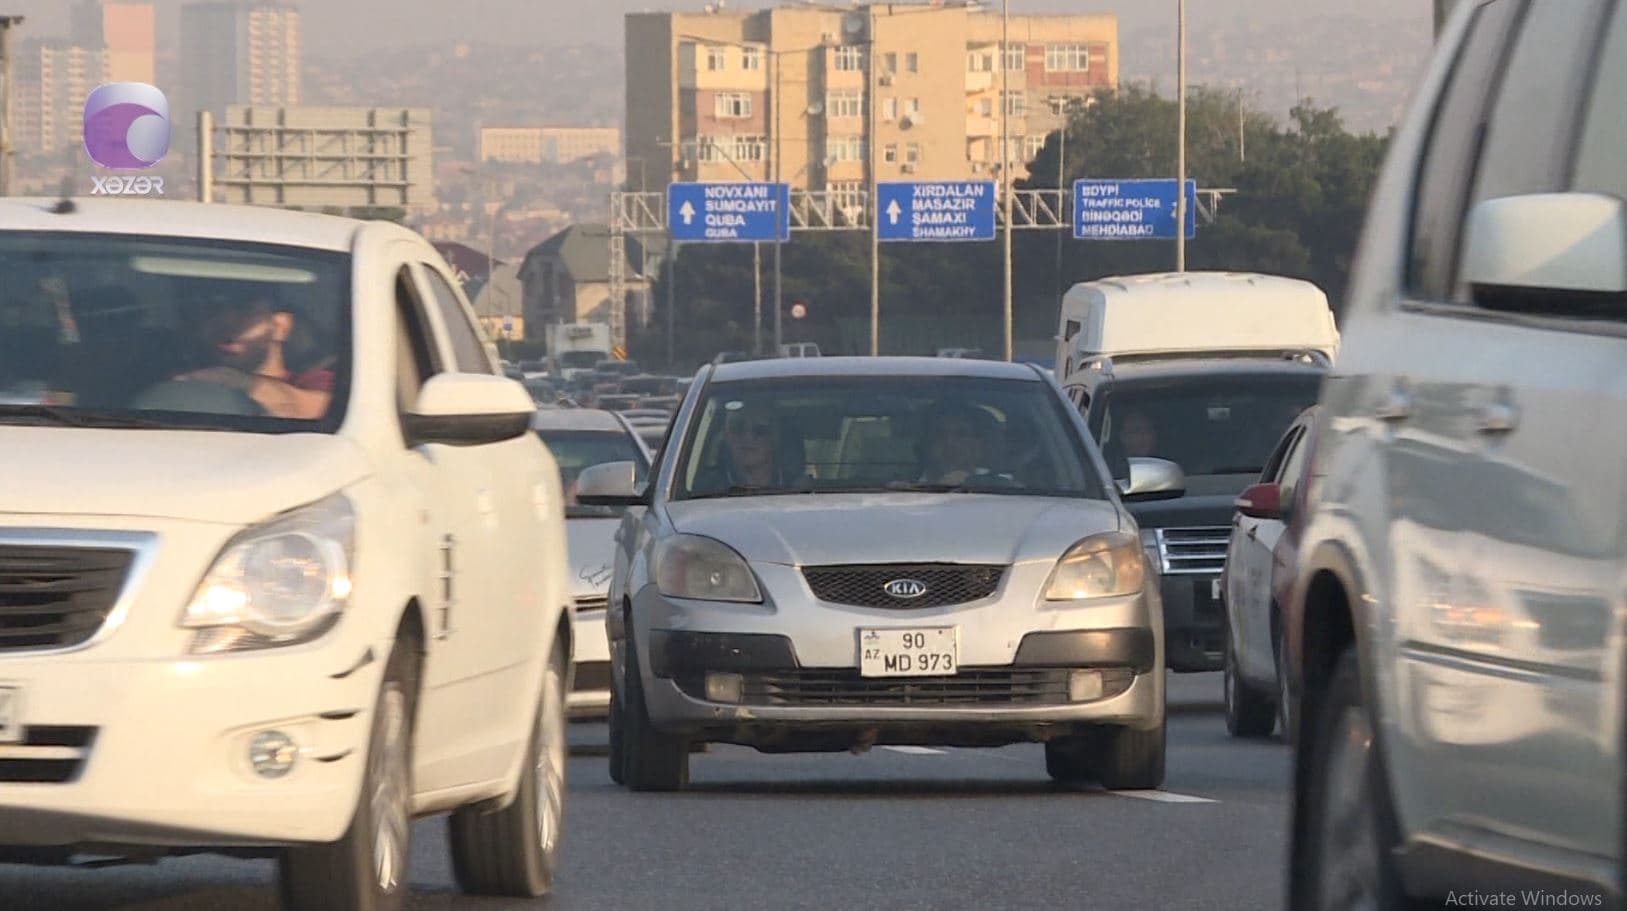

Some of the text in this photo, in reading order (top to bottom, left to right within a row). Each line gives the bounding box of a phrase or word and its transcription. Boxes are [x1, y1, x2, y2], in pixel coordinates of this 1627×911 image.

[705, 214, 746, 226] QUBA
[912, 226, 976, 237] SHAMAKHY
[892, 583, 920, 594] KIA
[903, 633, 925, 649] 90
[864, 649, 880, 660] AZ
[884, 654, 952, 672] MD 973
